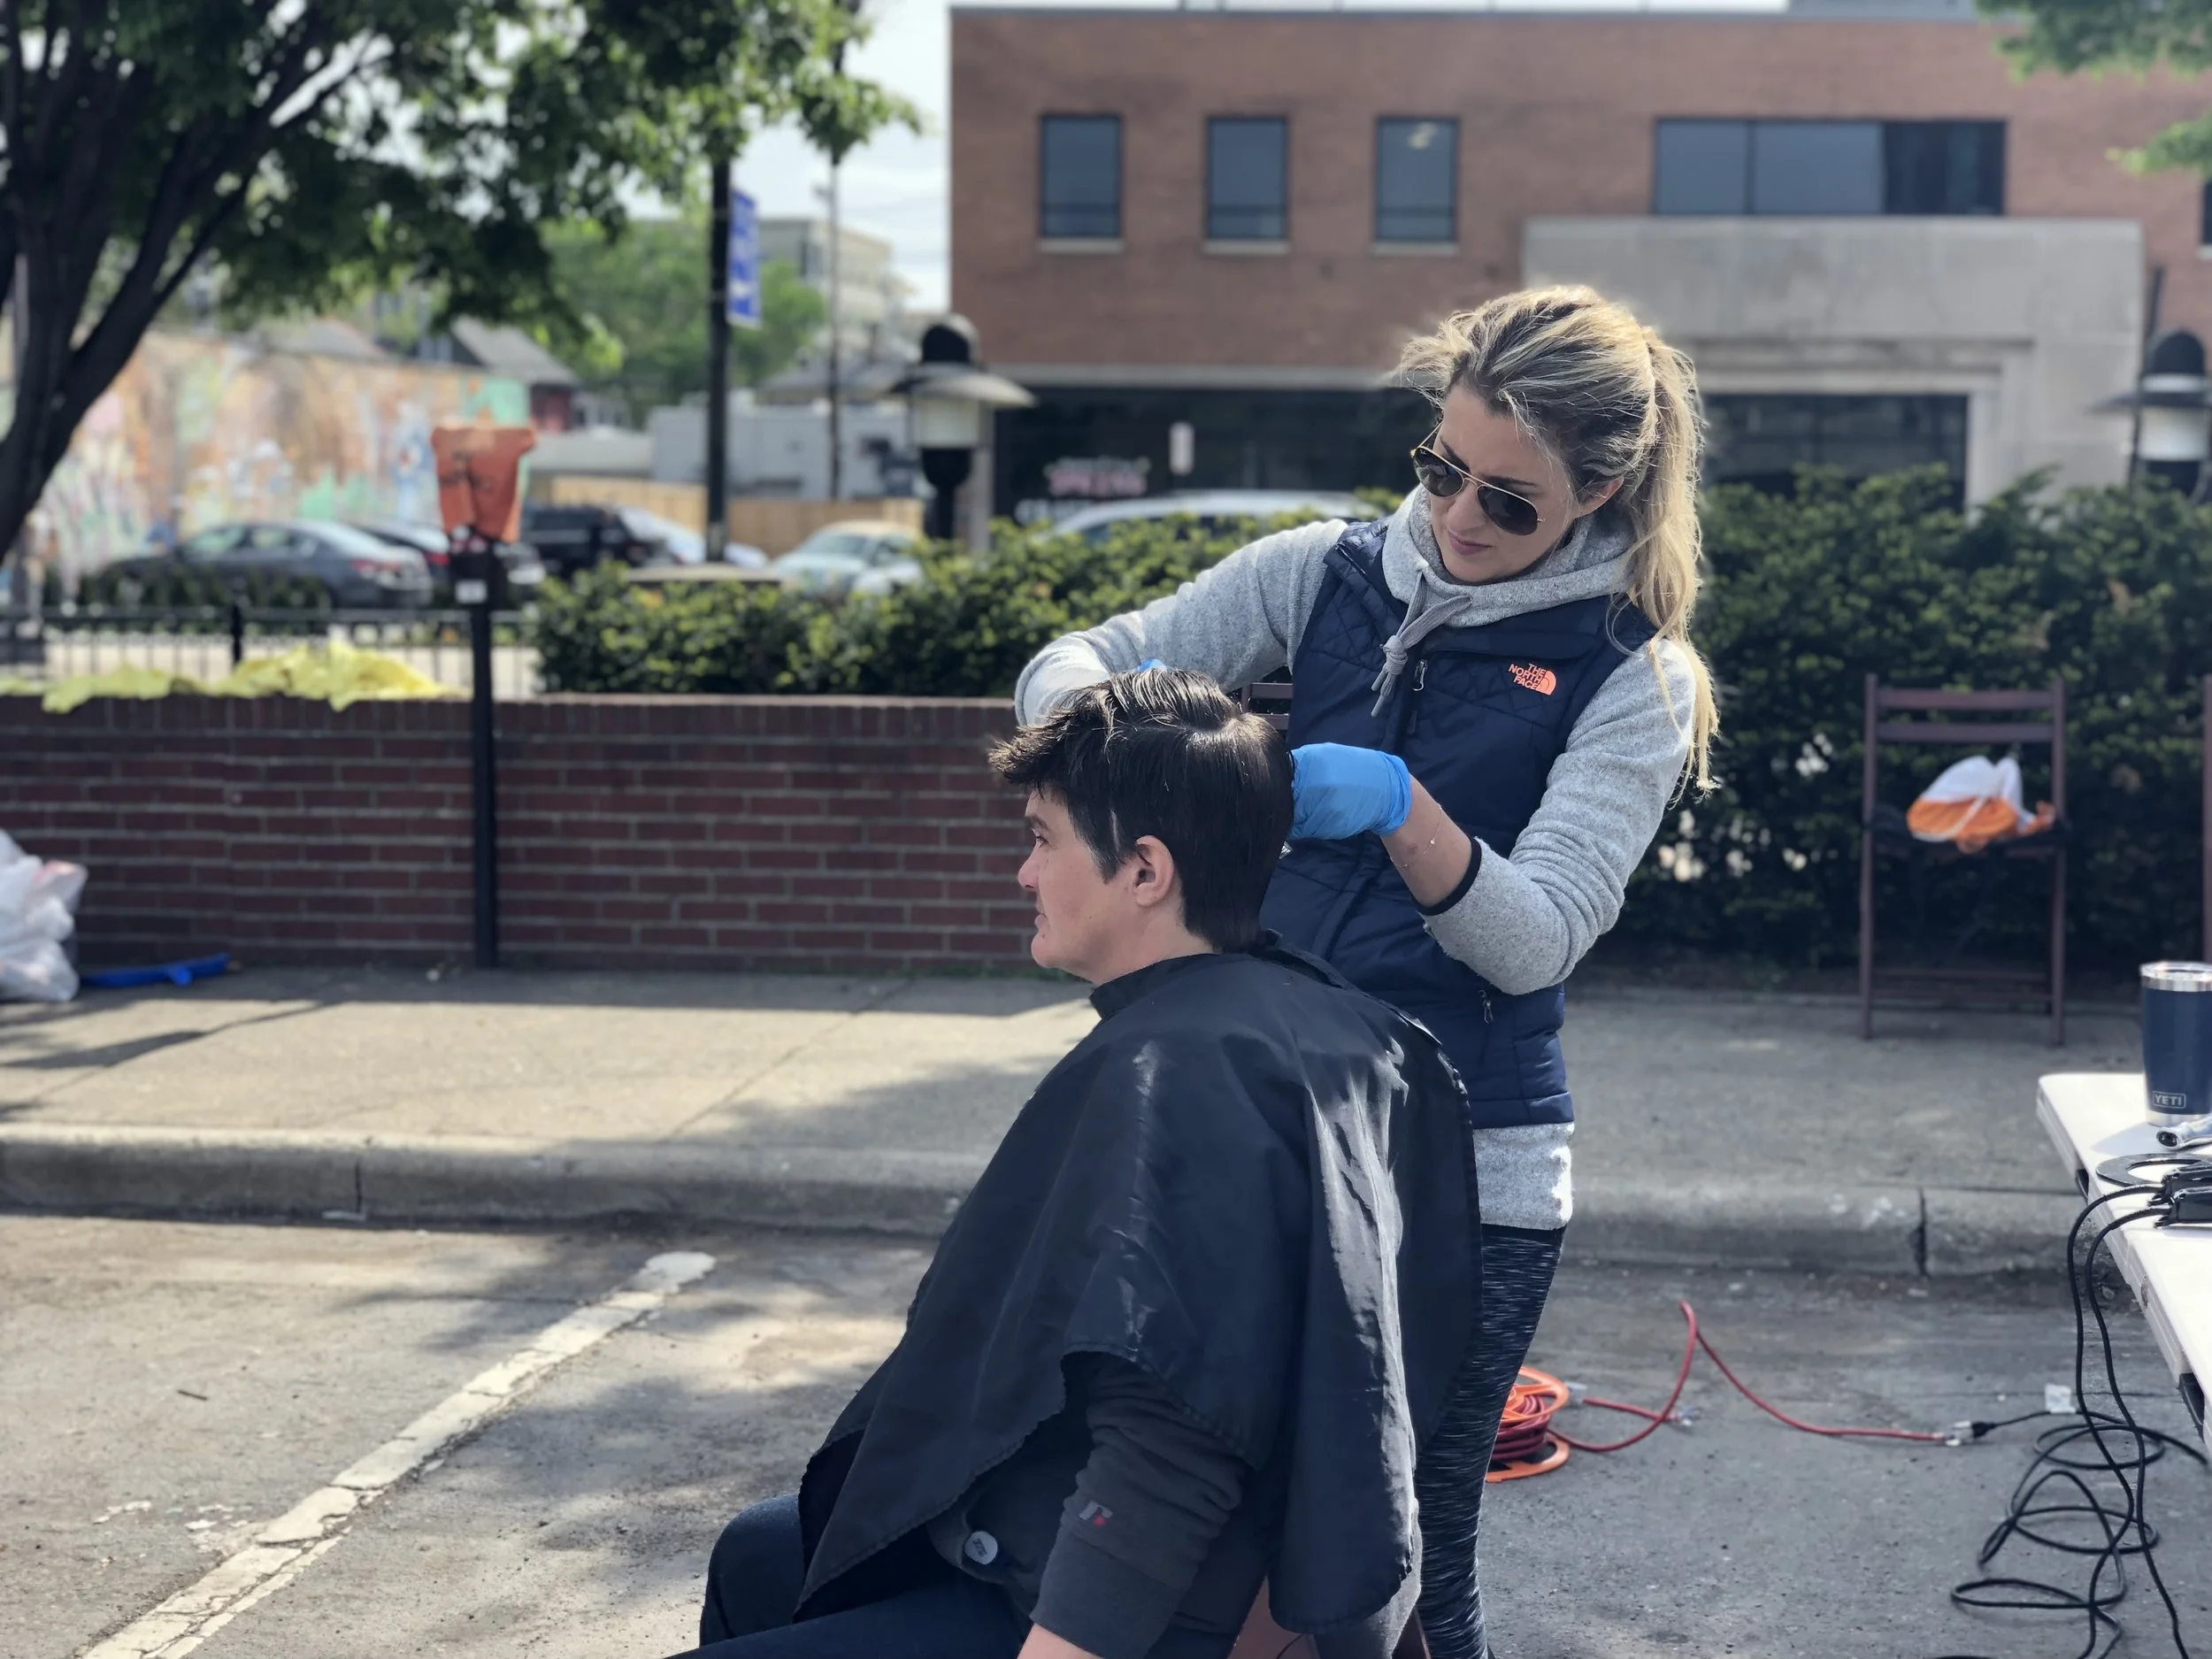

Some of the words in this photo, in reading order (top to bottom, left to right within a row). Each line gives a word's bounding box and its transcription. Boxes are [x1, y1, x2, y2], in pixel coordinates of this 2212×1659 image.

[1508, 664, 1543, 683] NORTH
[1528, 663, 1547, 677] THE
[1513, 675, 1539, 690] FACE
[2154, 1094, 2182, 1106] YETI
